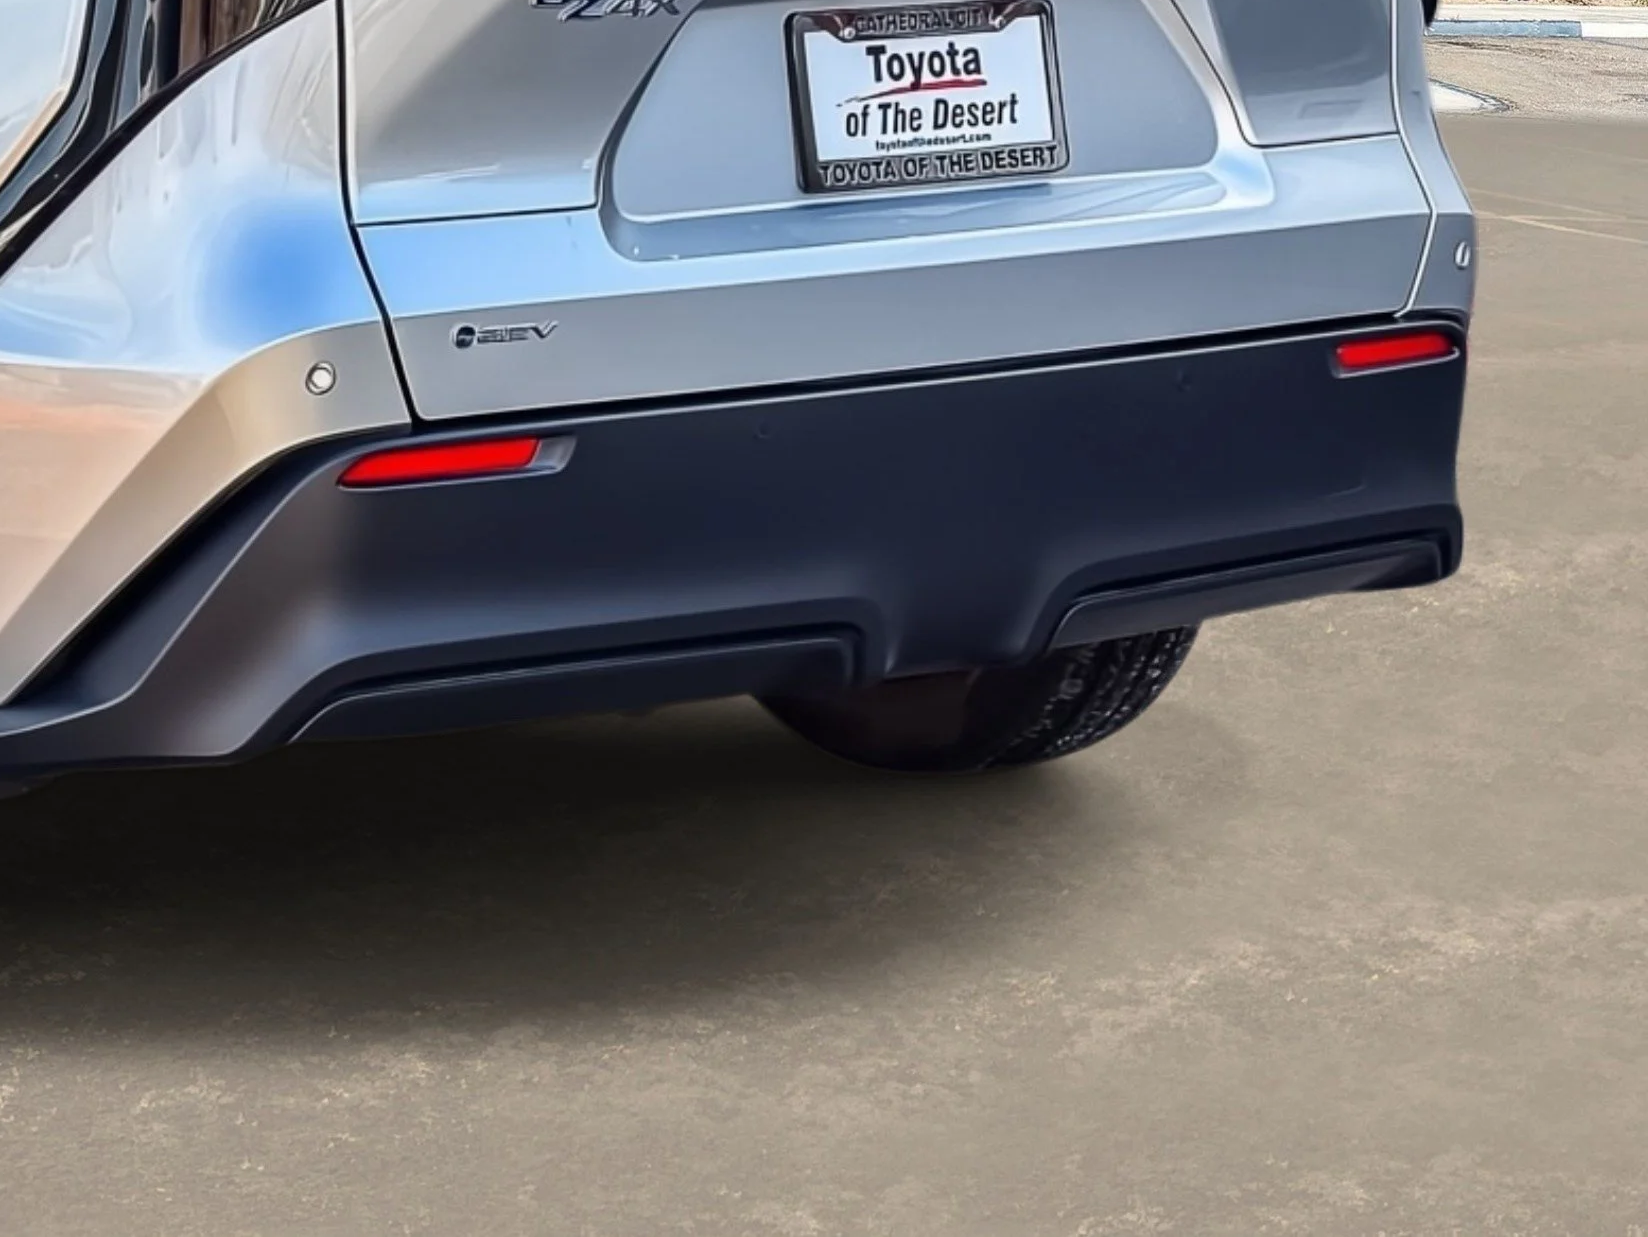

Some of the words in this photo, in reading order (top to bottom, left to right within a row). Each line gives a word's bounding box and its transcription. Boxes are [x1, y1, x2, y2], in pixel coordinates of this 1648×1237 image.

[854, 9, 952, 33] CATHEDRAL
[865, 41, 982, 88] Toyota
[846, 104, 870, 137] of
[878, 102, 922, 135] The
[933, 93, 1019, 130] Desert
[819, 158, 897, 186] TOYOTA
[902, 157, 932, 178] OF
[935, 153, 978, 175] THE
[980, 145, 1058, 170] DESERT
